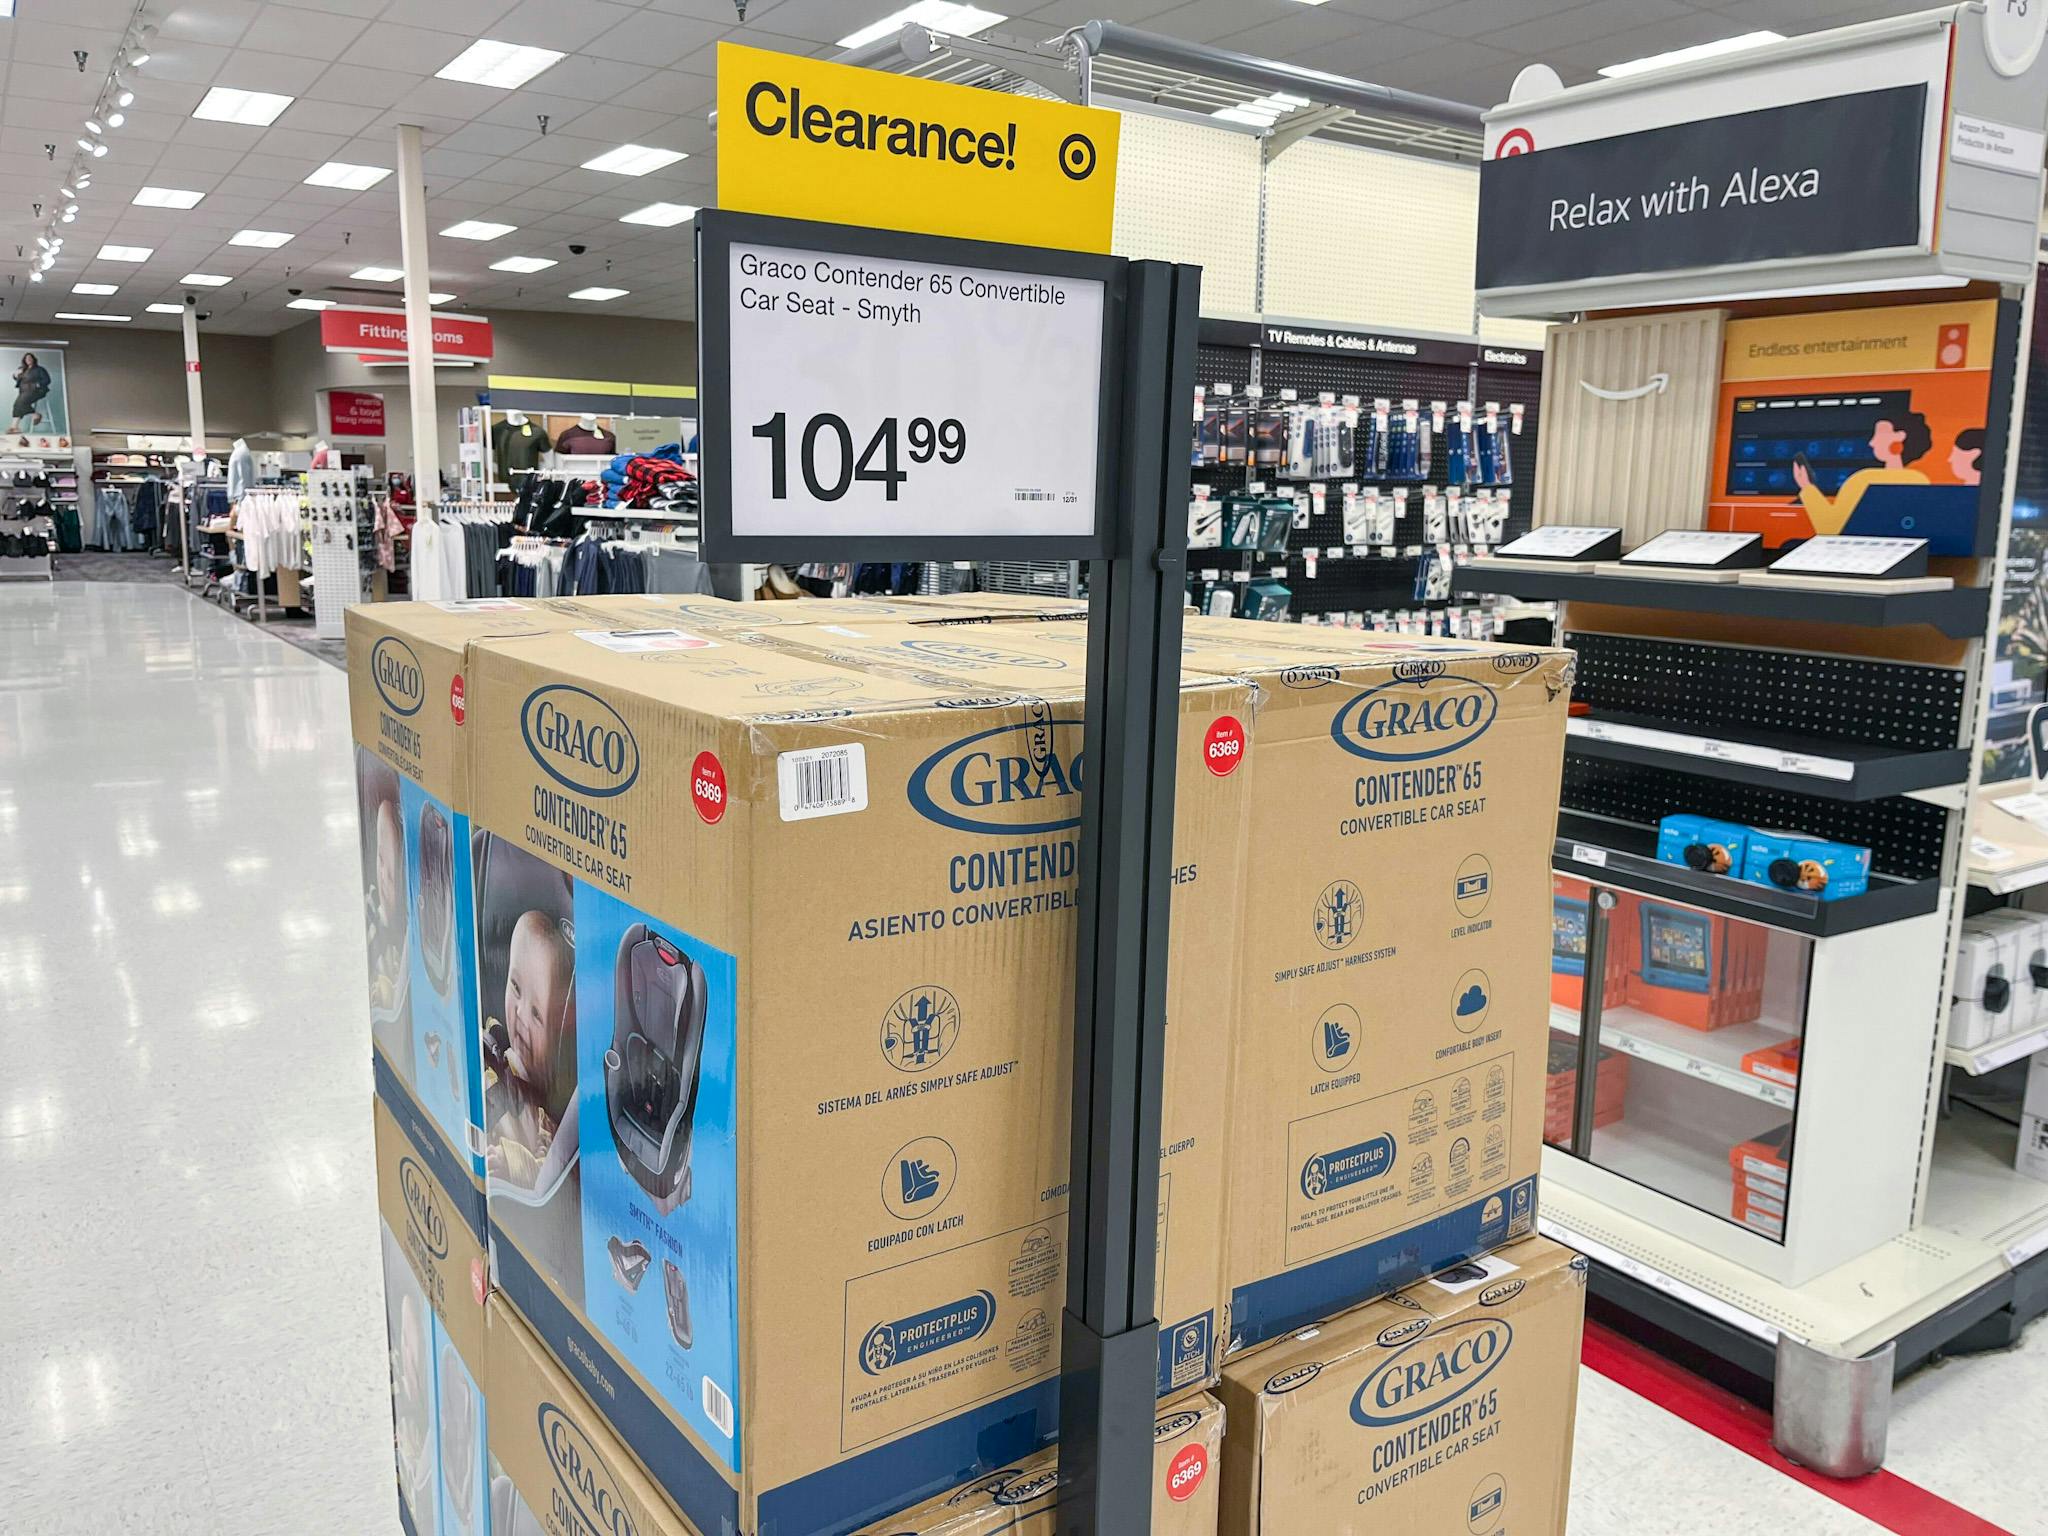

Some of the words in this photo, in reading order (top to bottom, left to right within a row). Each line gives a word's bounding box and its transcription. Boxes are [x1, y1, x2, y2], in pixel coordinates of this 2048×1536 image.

[745, 80, 1017, 171] Clearance!
[1549, 192, 1632, 232] Relax
[1640, 175, 1710, 219] with
[1720, 166, 1820, 208] Alexa
[739, 253, 807, 281] Graco
[813, 261, 924, 293] Contender
[928, 273, 953, 295] 65
[959, 277, 1066, 306] Convertible
[739, 287, 780, 312] Car
[785, 292, 835, 317] Seat
[857, 299, 922, 327] Smyth
[358, 323, 408, 343] Fitting
[1267, 329, 1284, 344] TV
[1283, 331, 1327, 347] Remotes
[1326, 335, 1335, 347] &
[1335, 335, 1368, 350] Cables
[1367, 338, 1377, 351] &
[1376, 339, 1417, 355] Antennas
[1748, 342, 1801, 359] Endless
[1803, 335, 1909, 355] entertainment
[1484, 349, 1527, 365] Electronics
[378, 649, 419, 699] GRACO
[1357, 694, 1484, 740] GRACO
[536, 700, 625, 775] GRACO
[1208, 739, 1240, 759] 6369
[694, 777, 722, 804] 6369
[1463, 760, 1483, 791] 65
[1340, 806, 1428, 836] CONVERTIBLE
[1429, 802, 1455, 821] CAR
[1456, 797, 1487, 816] SEAT
[609, 819, 628, 860] 65
[524, 823, 583, 870] CONVERTIBLE
[583, 853, 604, 881] CAR
[605, 864, 633, 894] SEAT
[949, 839, 1081, 894] CONTEND
[848, 909, 946, 942] ASIENTO
[1450, 926, 1467, 939] LEVEL
[1466, 919, 1493, 935] INDICATOR
[1274, 968, 1299, 983] SIMPLY
[1298, 964, 1316, 978] SAFE
[1344, 951, 1374, 967] HARNESS
[1373, 946, 1397, 961] SYSTEM
[1435, 1040, 1472, 1060] COMFORTABLE
[1485, 1029, 1503, 1043] INSERT
[817, 1095, 862, 1116] SISTEMA
[864, 1090, 884, 1106] DEL
[885, 1081, 918, 1102] ARNÉS
[920, 1074, 955, 1094] SIMPLY
[955, 1069, 979, 1086] SAFE
[1310, 1078, 1331, 1096] LATCH
[1330, 1072, 1361, 1090] EQUIPPED
[1168, 1136, 1195, 1156] CUERPO
[405, 1167, 443, 1247] GRACO
[1300, 1209, 1318, 1221] HELPS
[1318, 1207, 1326, 1215] TO
[1325, 1200, 1349, 1213] PROTECT
[1348, 1195, 1362, 1206] YOUR
[1362, 1190, 1378, 1201] LITTLE
[1379, 1187, 1389, 1195] ONE
[1330, 1210, 1344, 1220] REAR
[1344, 1207, 1355, 1216] AND
[1355, 1197, 1380, 1211] ROLLOVER
[655, 1225, 684, 1259] FASHION
[867, 1228, 914, 1253] EQUIPADO
[916, 1222, 935, 1239] CON
[937, 1214, 965, 1233] LATCH
[566, 1335, 616, 1401] gracobaby.com
[850, 1391, 872, 1404] AYUDA
[872, 1388, 878, 1396] A
[879, 1377, 911, 1394] PROTEGER
[912, 1374, 918, 1382] A
[918, 1371, 927, 1380] SU
[943, 1363, 952, 1371] EN
[953, 1357, 966, 1368] LAS
[965, 1344, 1000, 1362] COLISIONES
[928, 1367, 960, 1385] TRASERAS
[965, 1363, 974, 1371] DE
[1178, 1347, 1201, 1364] LATCH
[1375, 1328, 1497, 1409] GRACO
[1478, 1387, 1498, 1421] 65
[551, 1420, 632, 1536] GRACO
[1171, 1460, 1202, 1489] 6369
[1357, 1449, 1443, 1506] CONVERTIBLE
[1445, 1437, 1469, 1461] CAR
[1471, 1419, 1502, 1447] SEAT
